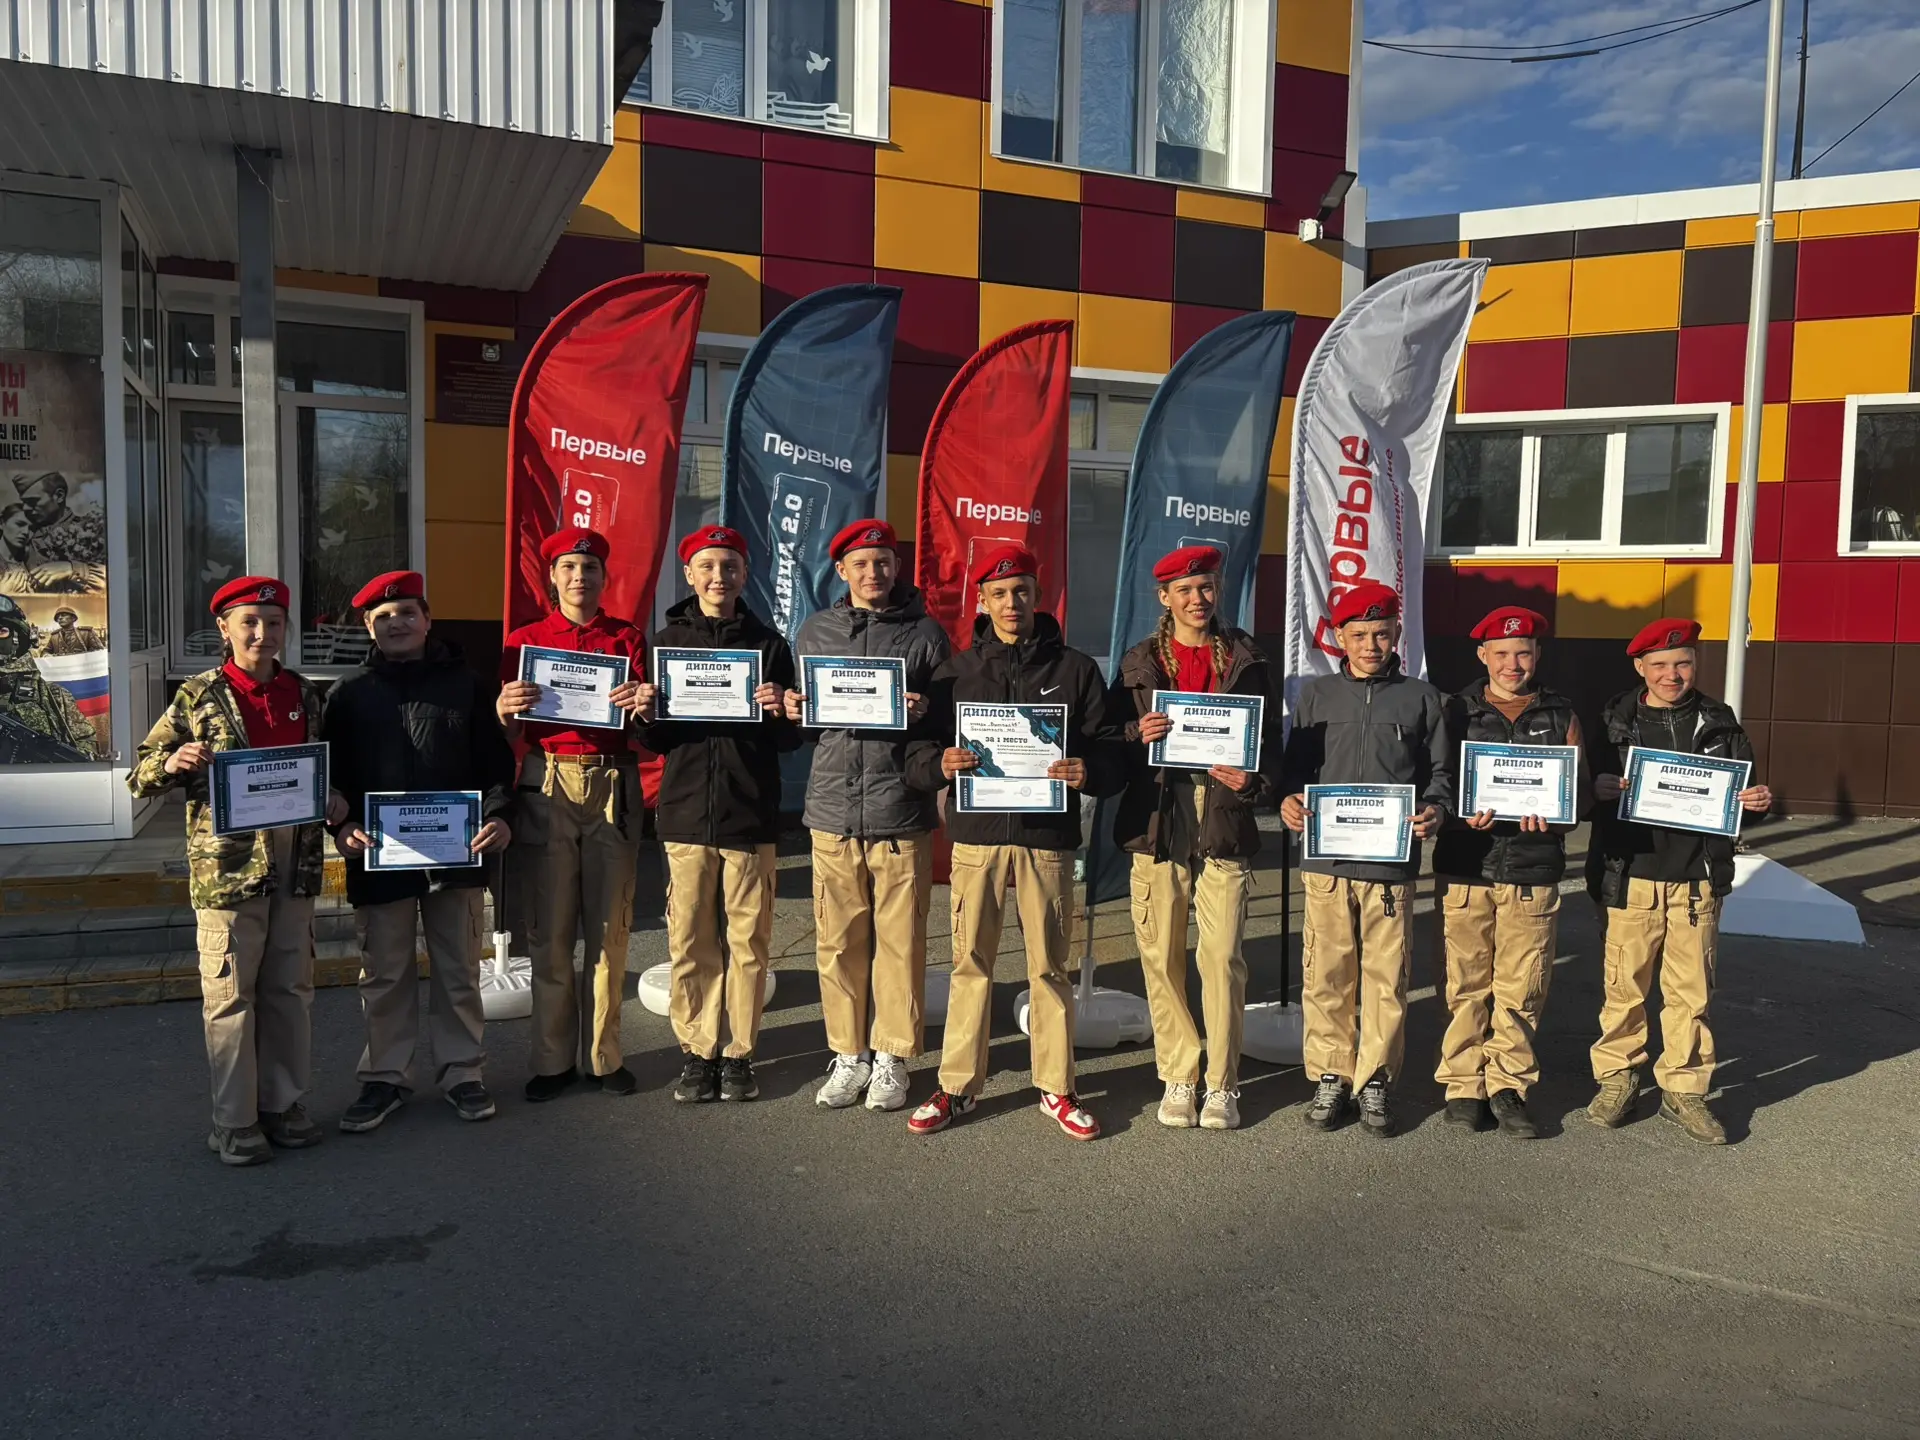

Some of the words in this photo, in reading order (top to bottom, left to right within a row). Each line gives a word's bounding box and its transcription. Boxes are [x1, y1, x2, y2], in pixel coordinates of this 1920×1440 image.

[12, 424, 37, 441] НАС
[551, 427, 647, 466] Первые
[763, 432, 853, 473] Первые
[572, 489, 593, 529] 2.0
[780, 493, 803, 535] 2.0
[956, 496, 1042, 527] Первые
[1165, 495, 1251, 527] Первые
[772, 541, 797, 639] РНИЦА
[551, 663, 598, 675] ДИПЛОМ
[685, 663, 732, 671] ДИПЛОМ
[831, 669, 876, 678] ДИПЛОМ
[963, 707, 1016, 718] ДИПЛОМ
[1183, 707, 1231, 717] ДИПЛОМ
[247, 761, 298, 774] ДИПЛОМ
[1493, 758, 1544, 768] ДИПЛОМ
[1660, 765, 1713, 779] ДИПЛОМ
[1336, 798, 1385, 807] ДИПЛОМ
[399, 806, 449, 816] ДИПЛОМ
